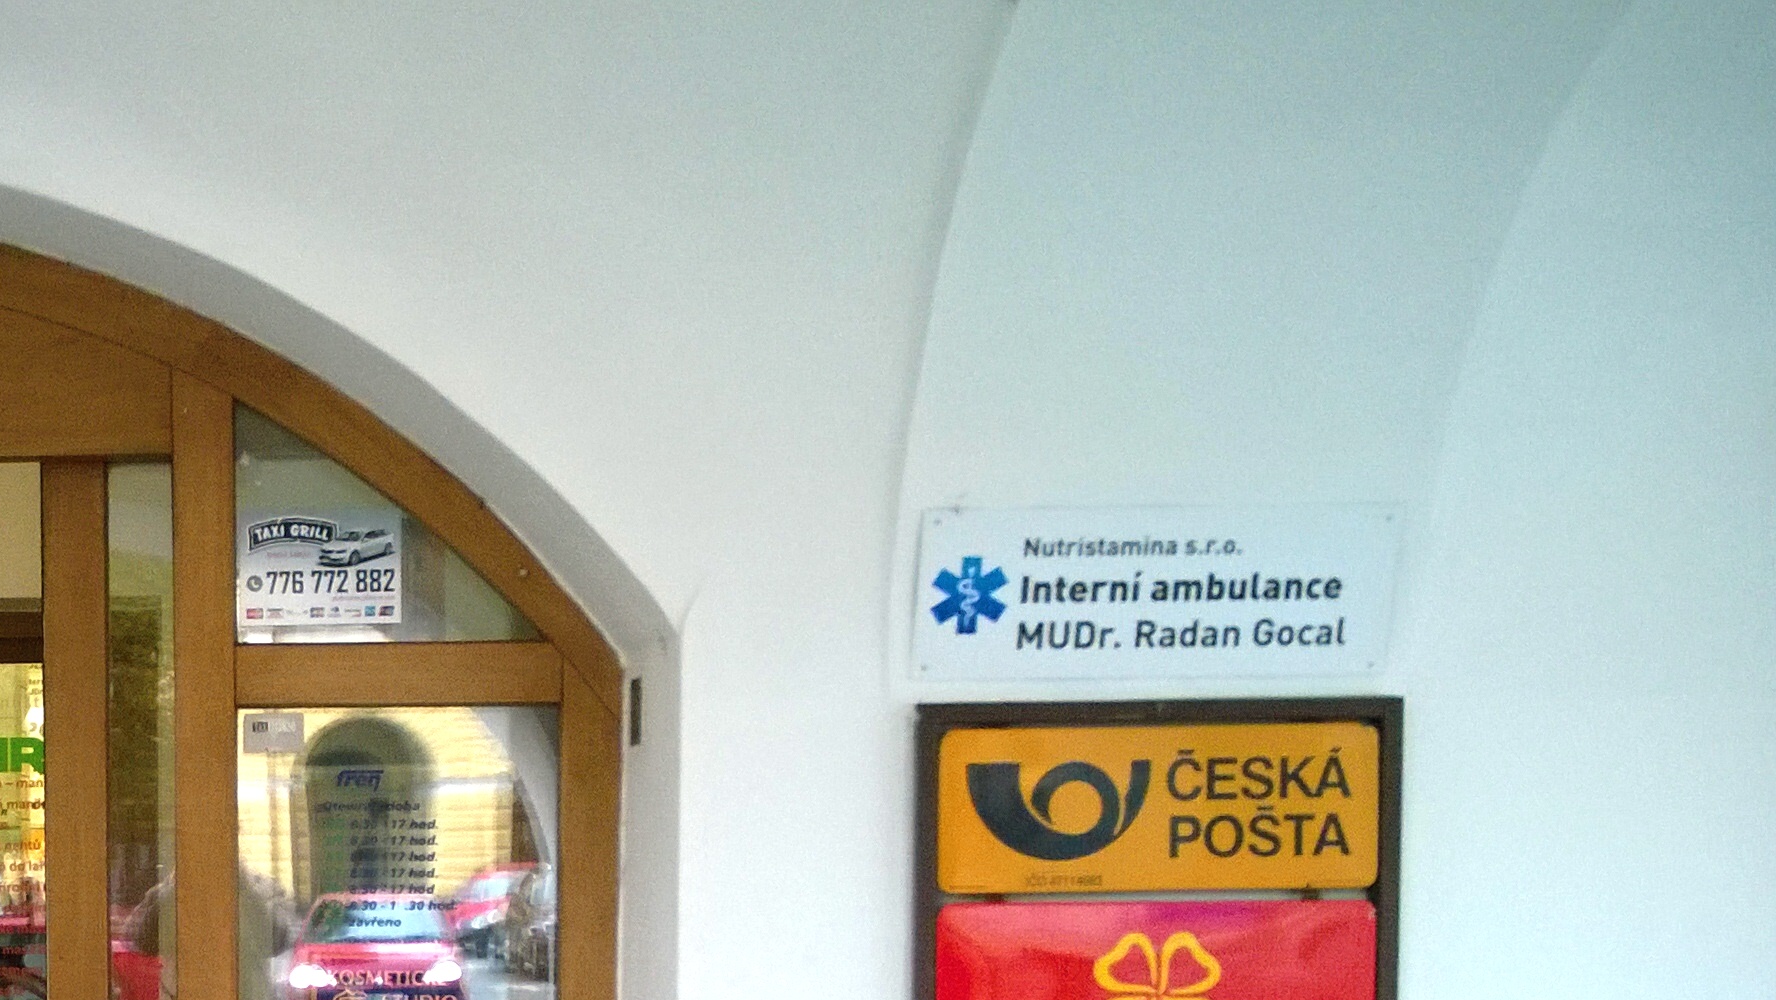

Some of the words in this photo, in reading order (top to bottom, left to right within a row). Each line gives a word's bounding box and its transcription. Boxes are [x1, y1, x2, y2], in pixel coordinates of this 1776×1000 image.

[254, 524, 285, 542] TAXI
[290, 523, 329, 541] GRILL
[1024, 536, 1177, 558] Nutristamina
[1185, 538, 1242, 557] s.r.o.
[266, 570, 304, 595] 776
[311, 570, 348, 594] 772
[356, 568, 395, 592] 882
[1020, 570, 1141, 604] Interní
[1151, 568, 1343, 601] ambulance
[1016, 621, 1122, 650] MUDr.
[1134, 619, 1241, 648] Radan
[1253, 617, 1346, 647] Gocal
[1166, 747, 1352, 801] ČESKÁ
[1168, 806, 1350, 858] POŠTA
